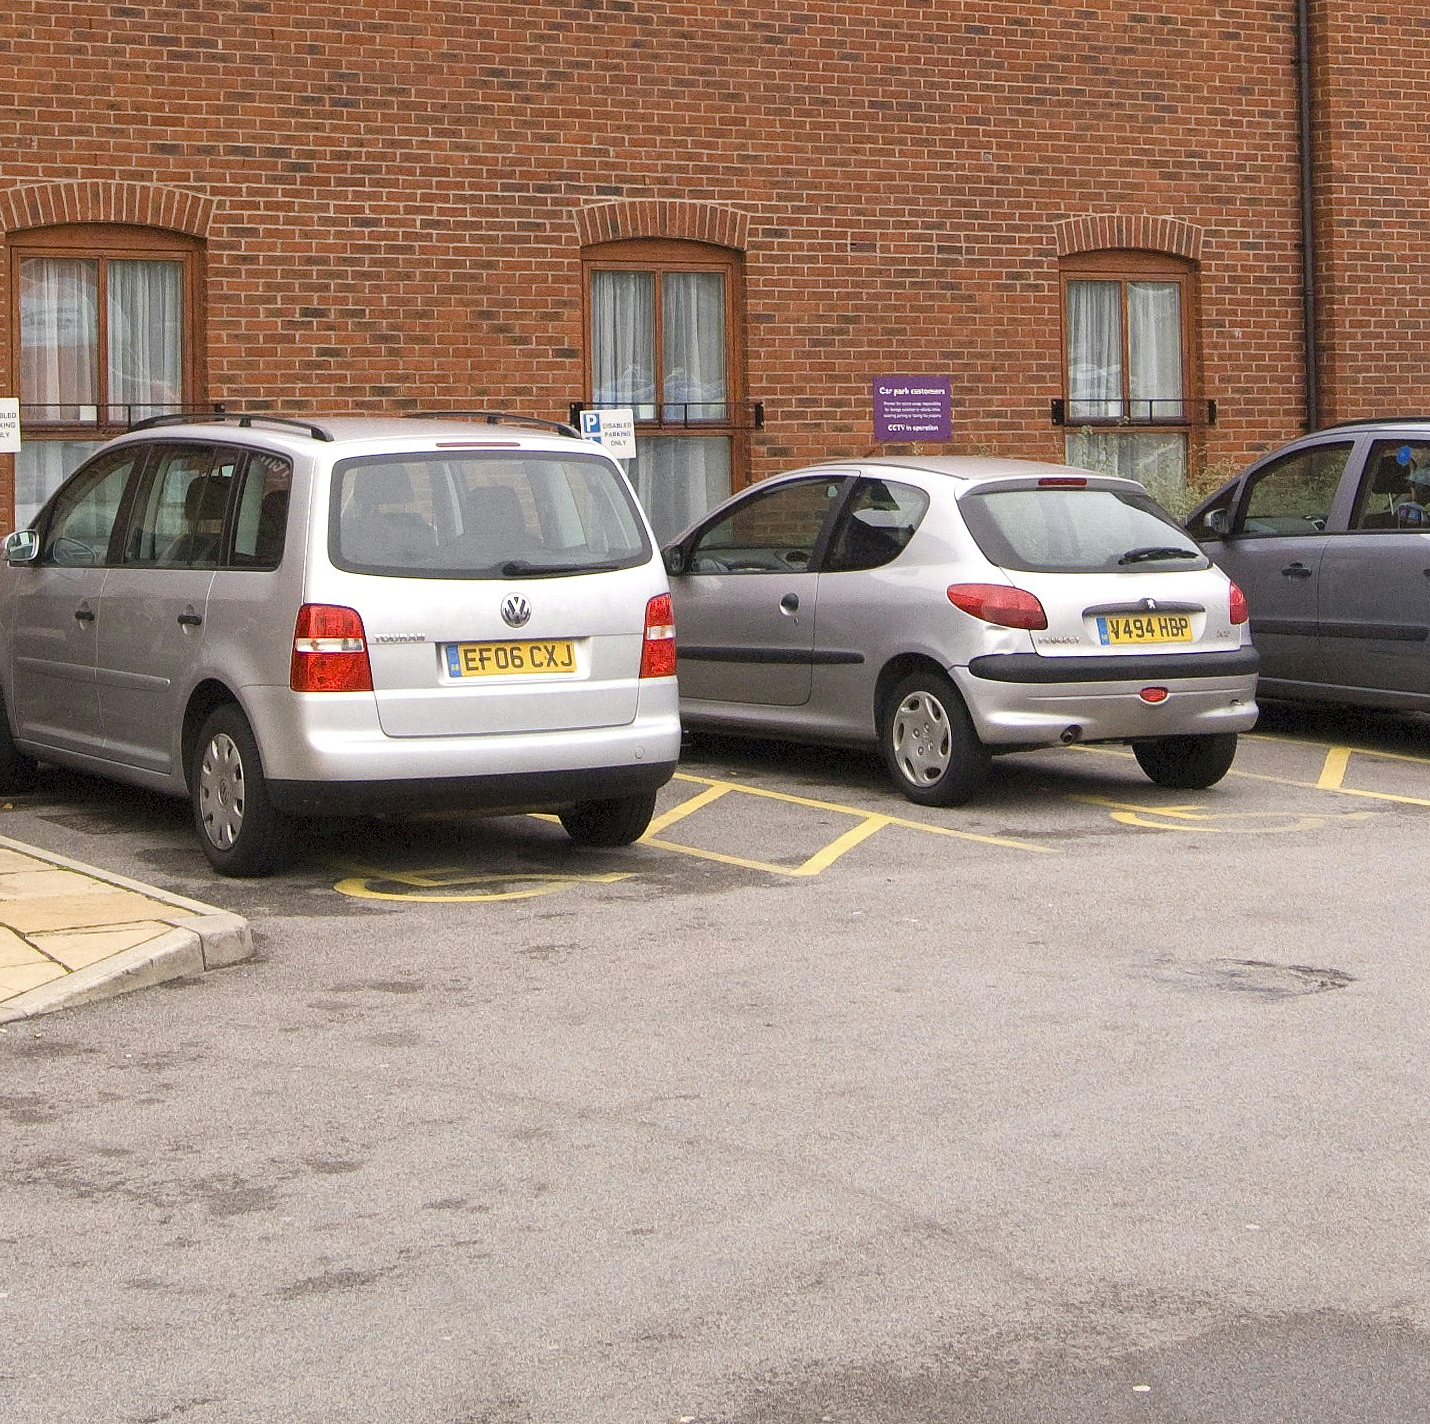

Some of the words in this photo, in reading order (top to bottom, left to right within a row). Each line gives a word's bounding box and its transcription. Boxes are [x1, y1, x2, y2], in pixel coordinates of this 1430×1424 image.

[879, 386, 892, 395] Car
[893, 386, 909, 397] park
[910, 387, 946, 395] customers
[585, 414, 598, 432] P
[602, 422, 632, 430] DISABLED
[887, 424, 905, 432] CCTV
[912, 424, 939, 433] operation
[604, 430, 631, 438] PARKING
[1108, 617, 1156, 640] V494
[1157, 616, 1190, 638] HBP
[463, 646, 525, 672] EF06
[528, 643, 573, 669] CXJ
